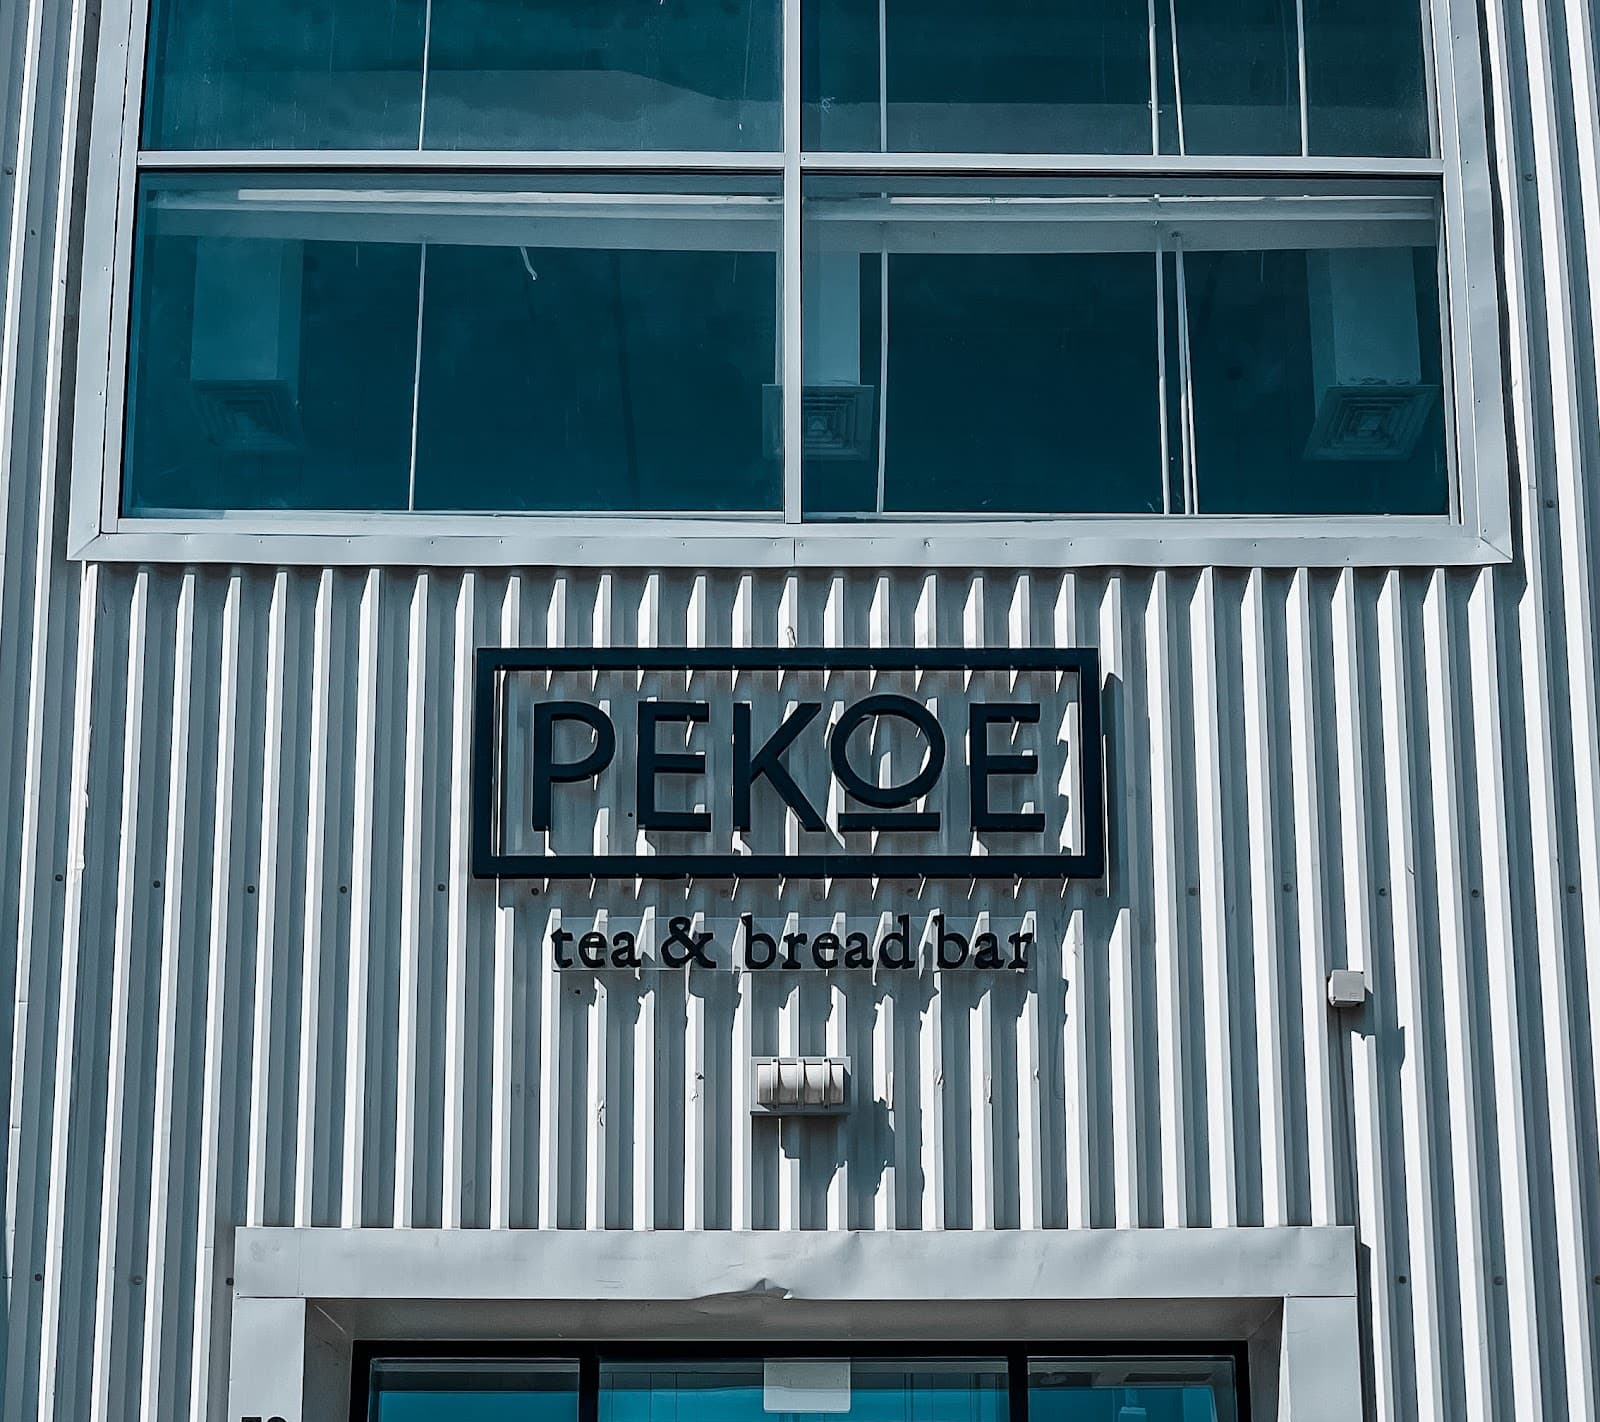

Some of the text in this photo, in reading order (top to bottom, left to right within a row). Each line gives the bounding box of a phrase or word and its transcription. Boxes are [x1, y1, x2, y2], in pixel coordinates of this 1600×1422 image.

[532, 694, 1046, 832] PEKOE
[550, 913, 1033, 969] tea & bread bar
